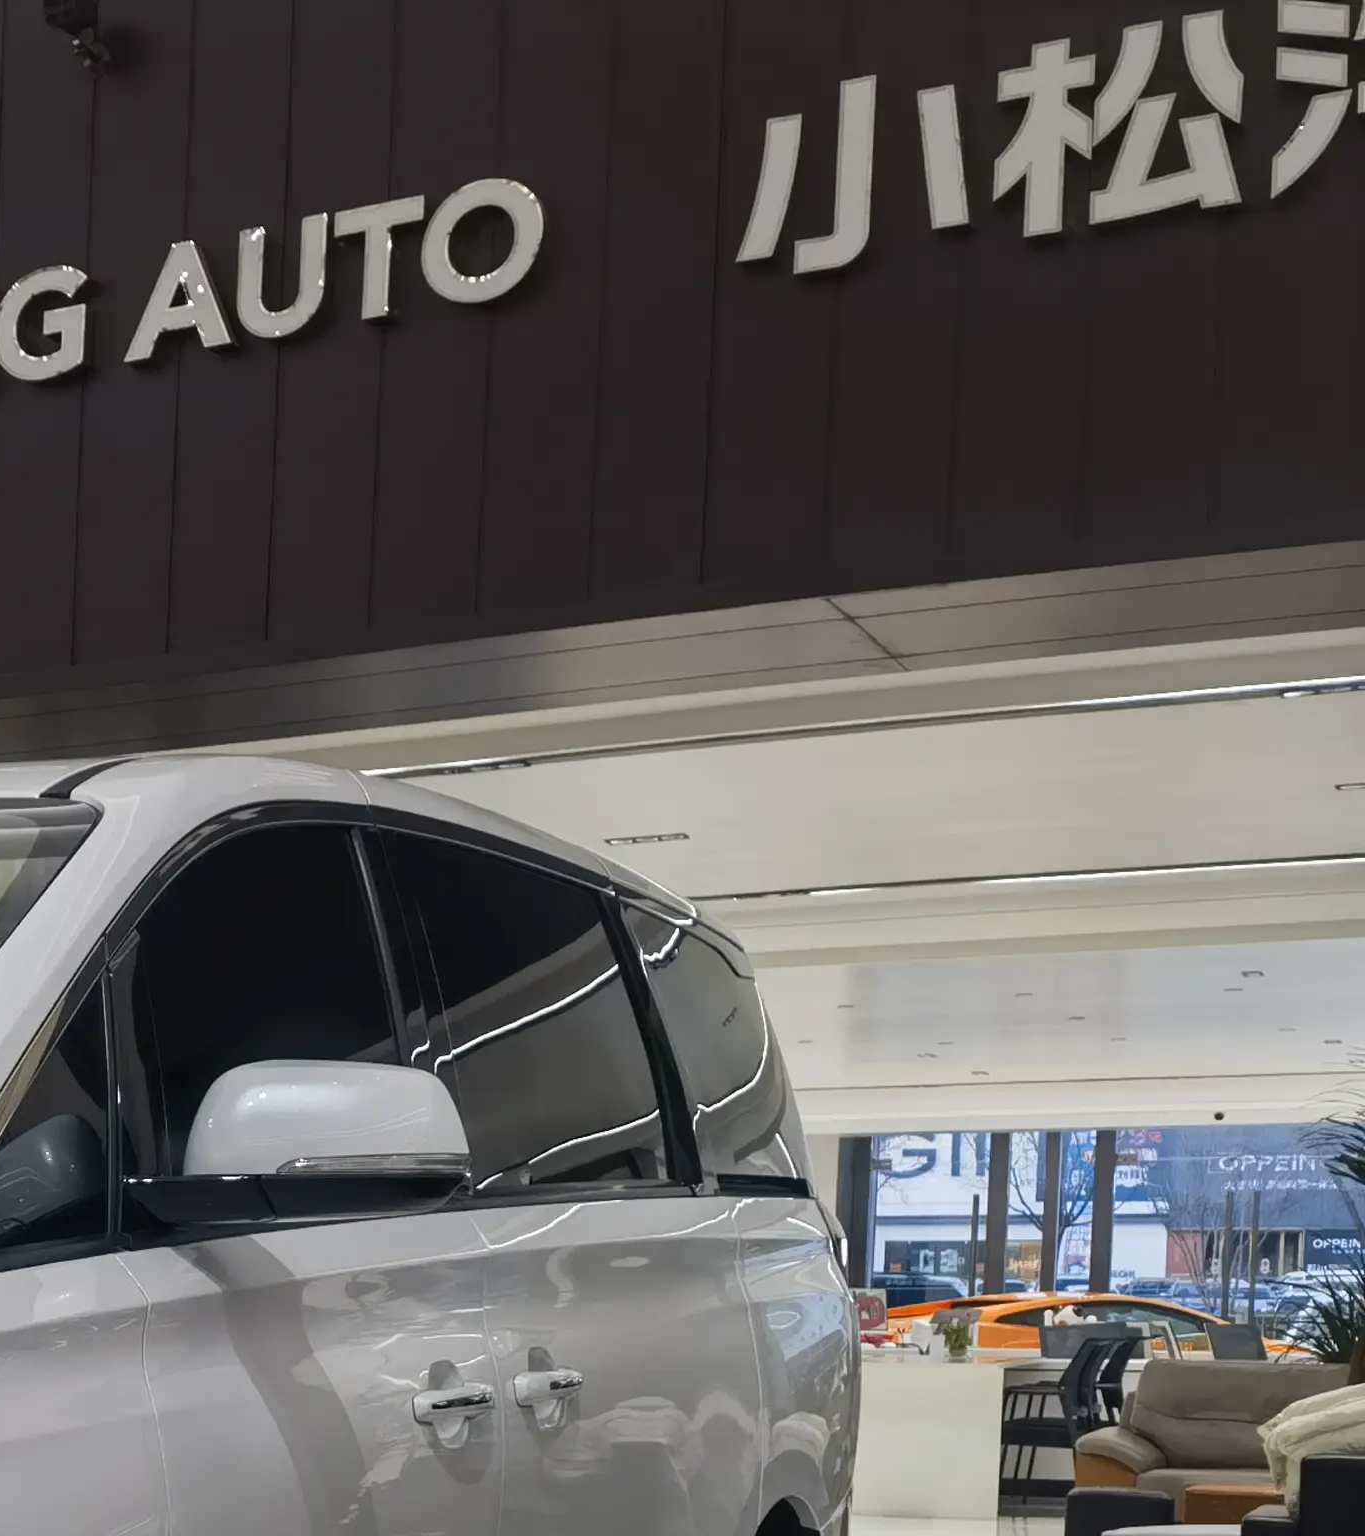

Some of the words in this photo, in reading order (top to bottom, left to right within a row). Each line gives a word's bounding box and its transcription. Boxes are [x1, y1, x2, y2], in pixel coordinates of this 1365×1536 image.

[124, 177, 546, 364] AUTO
[1218, 1153, 1316, 1172] OPPEIN
[1312, 1238, 1362, 1249] OPPEIN
